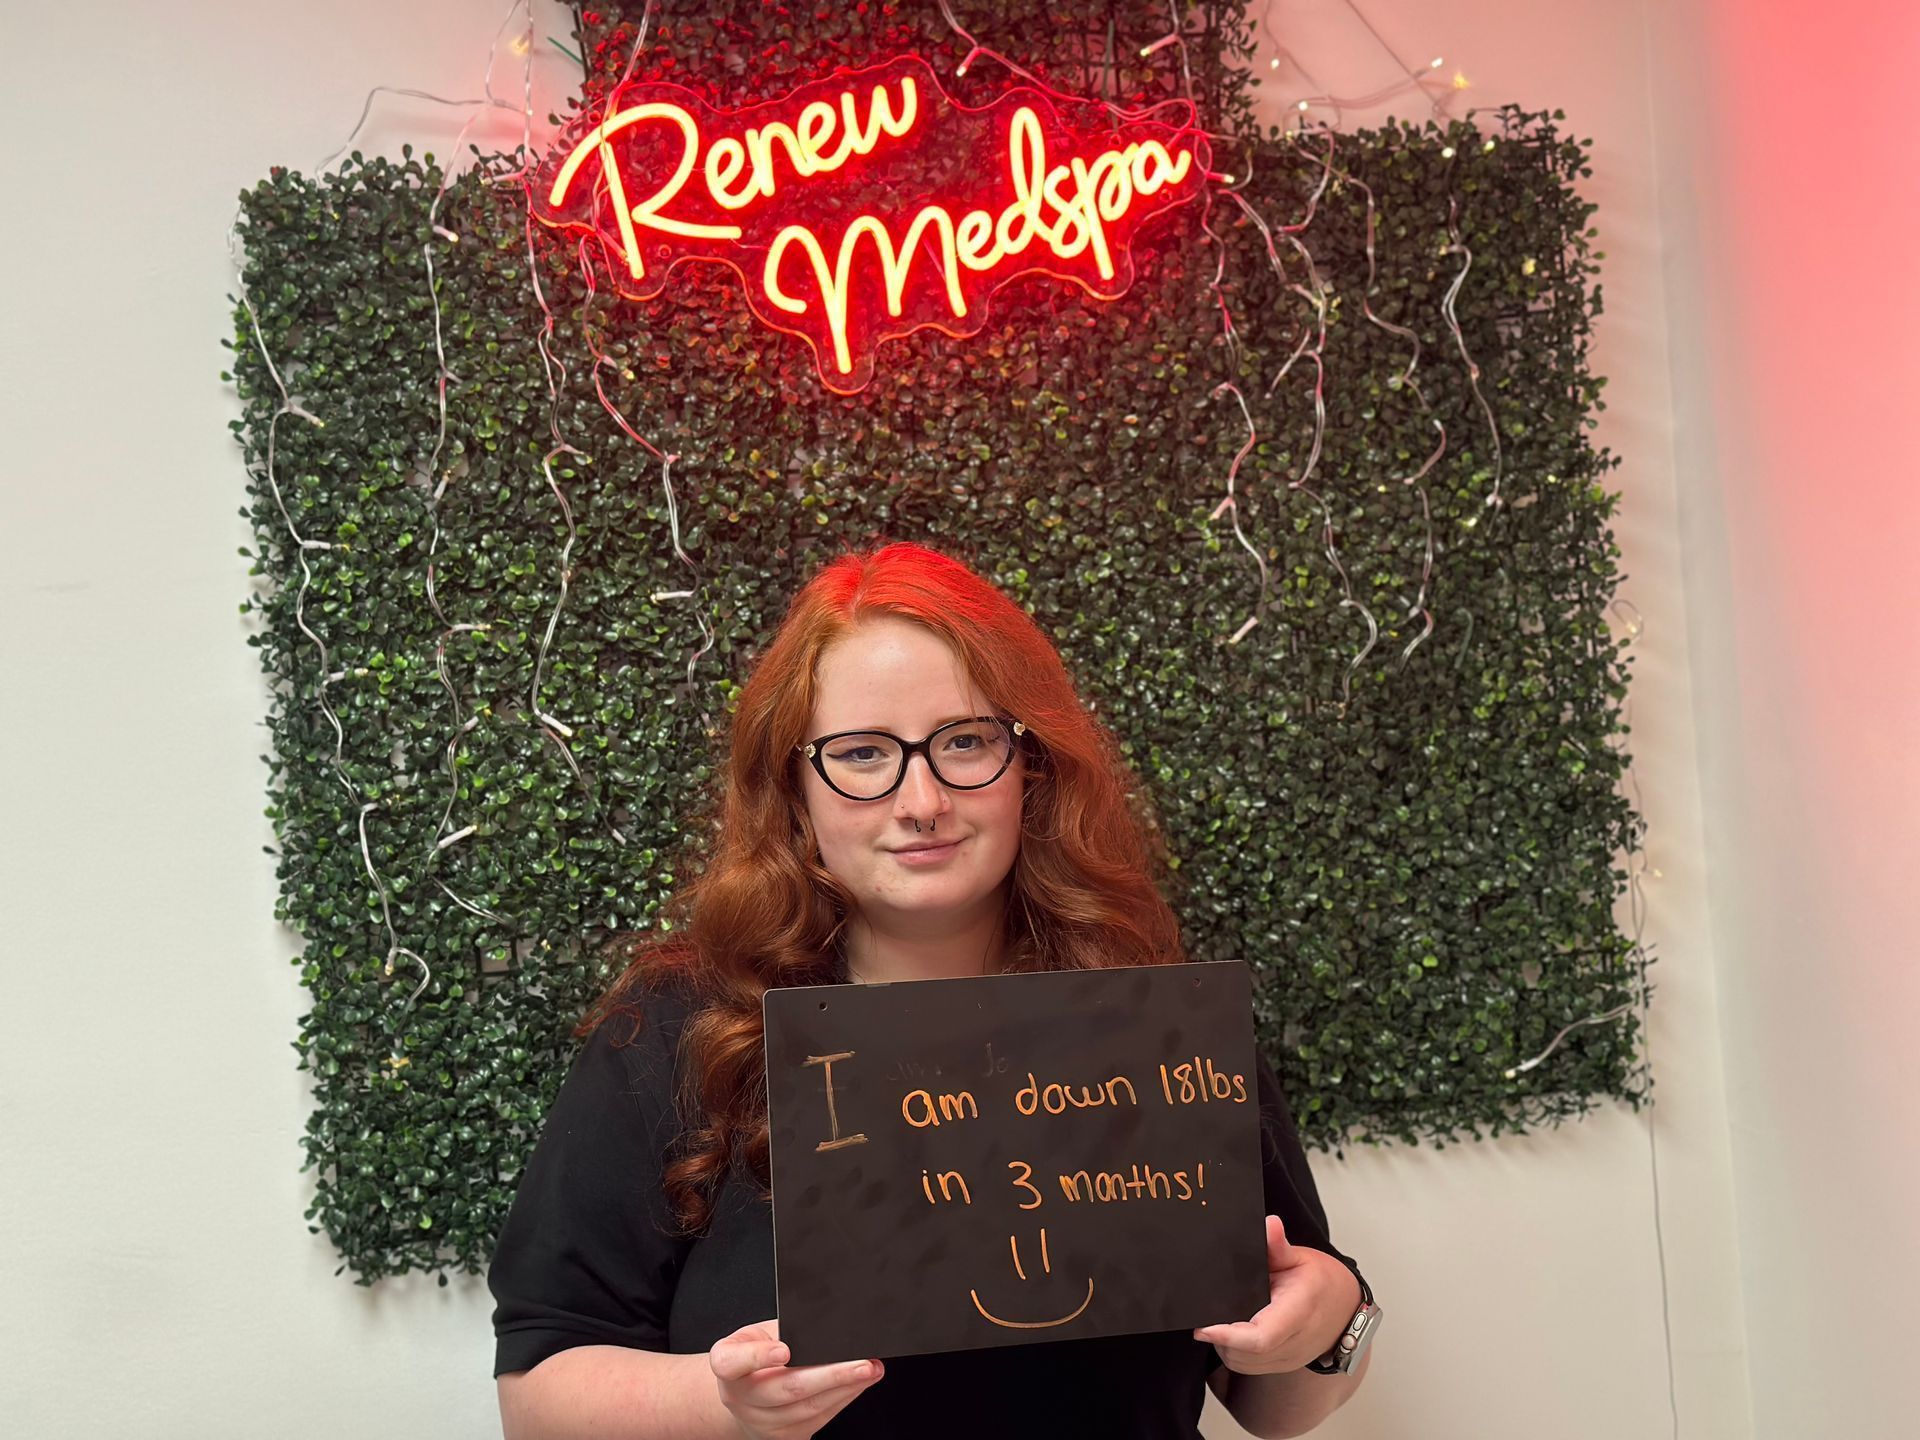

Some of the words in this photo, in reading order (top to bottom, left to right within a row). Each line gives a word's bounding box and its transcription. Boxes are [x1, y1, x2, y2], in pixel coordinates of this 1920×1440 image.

[548, 76, 917, 280] Renew
[762, 105, 1193, 375] Medspa
[803, 1050, 868, 1152] I
[902, 1089, 979, 1128] am
[1014, 1072, 1137, 1115] down
[1160, 1056, 1248, 1105] 18lbs
[921, 1169, 972, 1205] in
[1007, 1161, 1042, 1210] 3
[1058, 1162, 1208, 1206] months!
